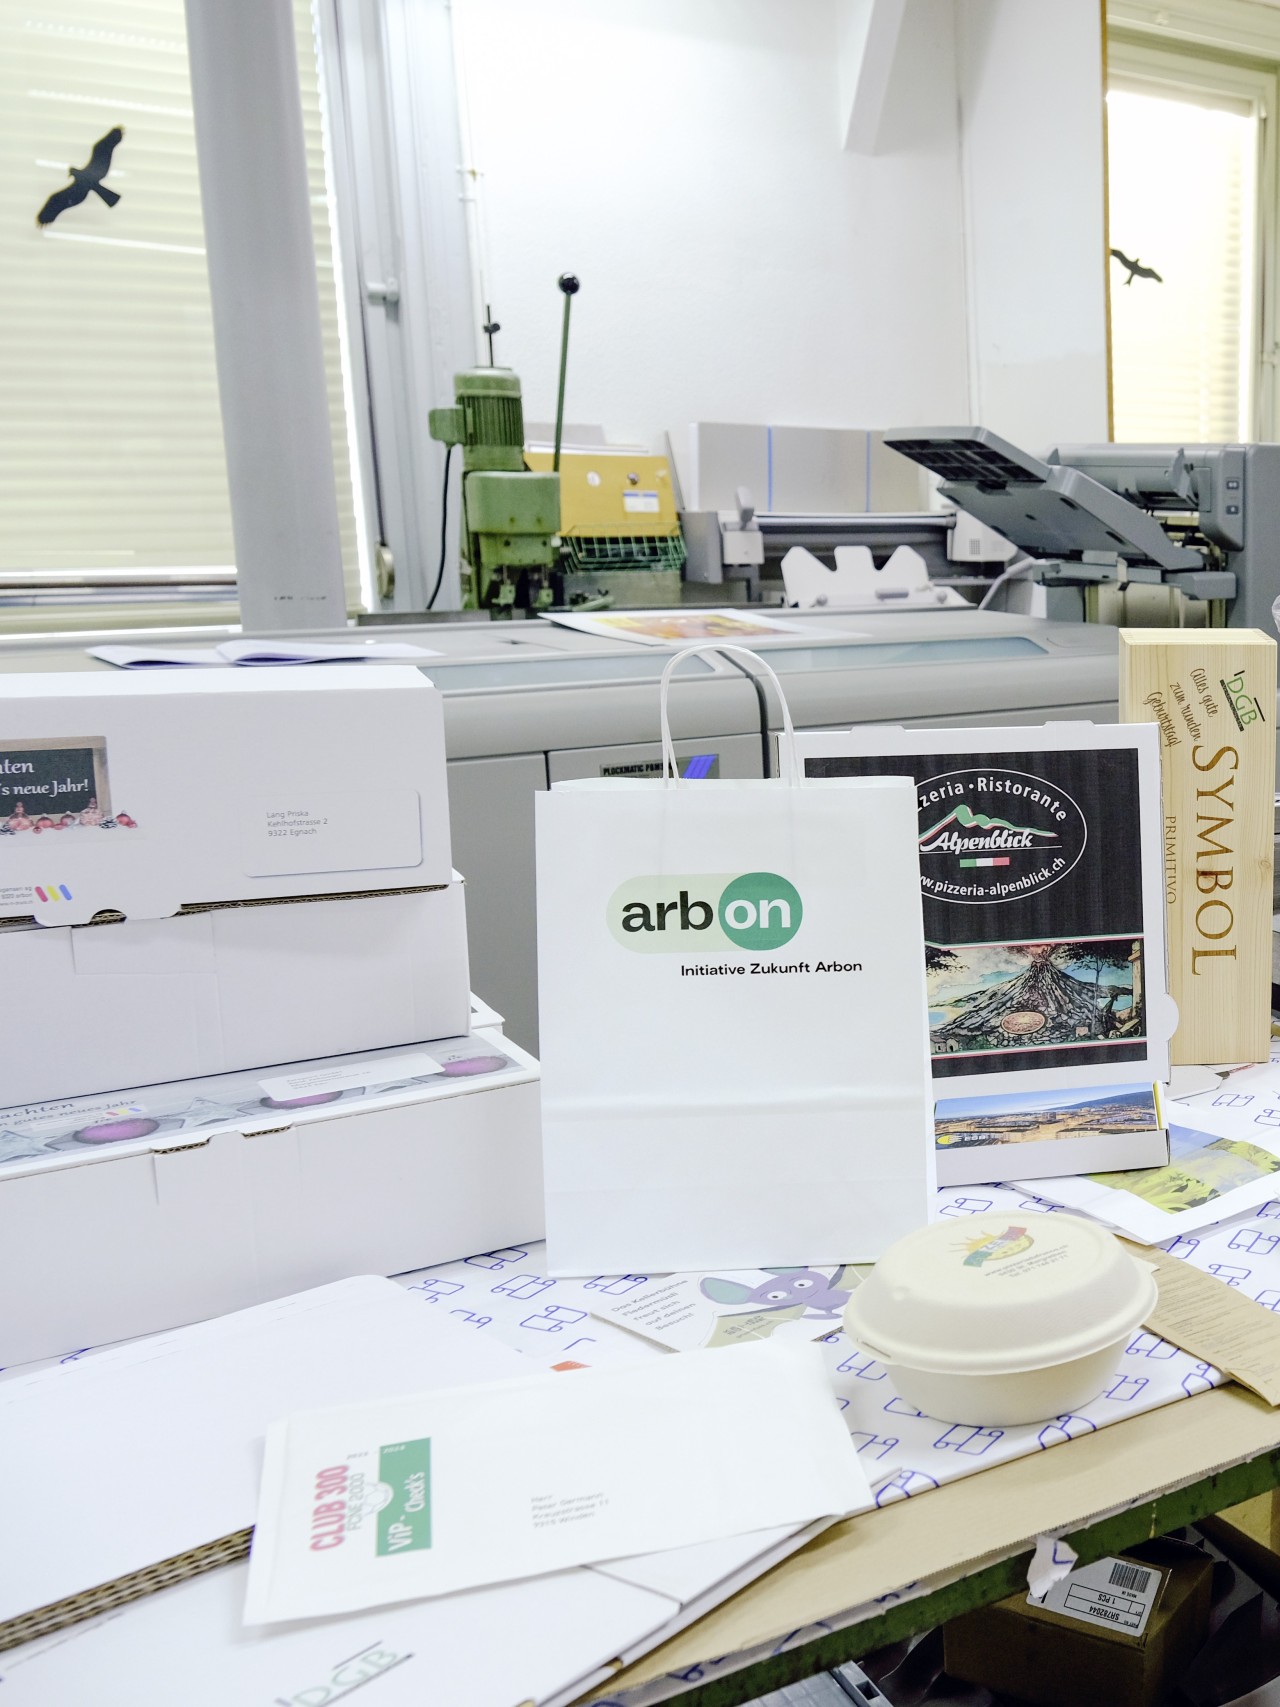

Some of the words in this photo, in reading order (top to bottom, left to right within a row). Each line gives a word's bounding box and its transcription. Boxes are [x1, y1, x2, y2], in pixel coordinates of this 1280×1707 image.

[13, 784, 50, 795] neue
[49, 778, 89, 798] Jahr!
[977, 777, 1068, 821] Ristorante
[920, 829, 1034, 855] Alpenblick
[1165, 815, 1177, 905] PRIMITIVO
[1191, 745, 1240, 976] SYMBOL
[681, 963, 746, 976] Initiative
[750, 961, 811, 975] Zukunft
[814, 960, 863, 973] Arbon
[315, 1464, 350, 1501] 300
[309, 1498, 347, 1552] CLUB
[1097, 1593, 1110, 1603] PCS
